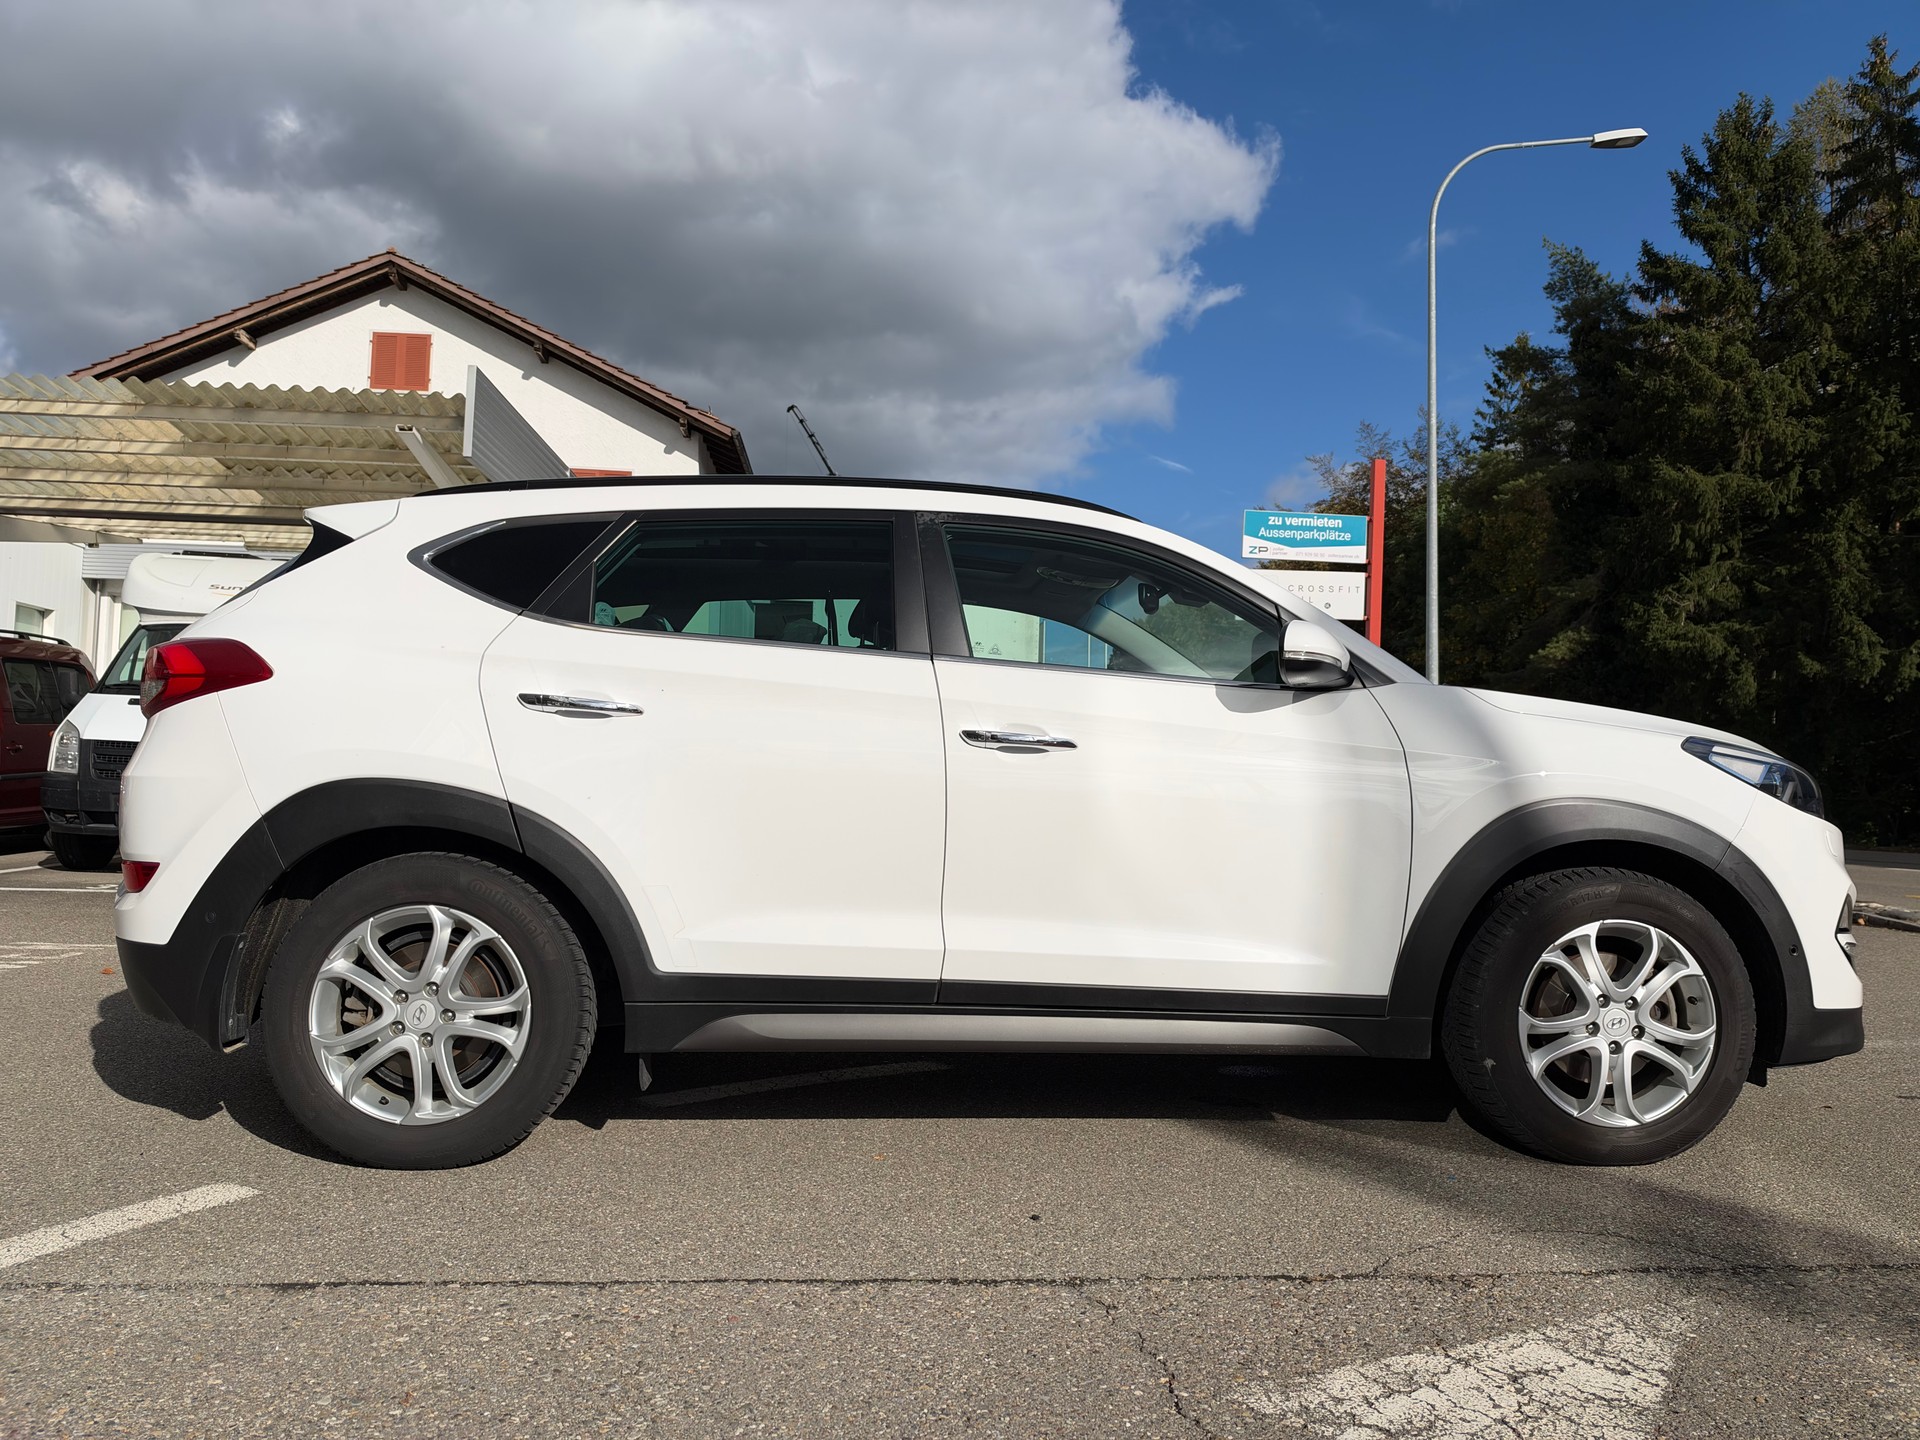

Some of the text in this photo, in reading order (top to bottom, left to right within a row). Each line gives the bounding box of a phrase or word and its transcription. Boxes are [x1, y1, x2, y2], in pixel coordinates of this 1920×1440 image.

[1268, 516, 1342, 528] zu vermieten
[1258, 527, 1352, 541] Aussenparkplätze
[1248, 546, 1269, 555] ZP
[1287, 584, 1361, 594] CROSSFIT
